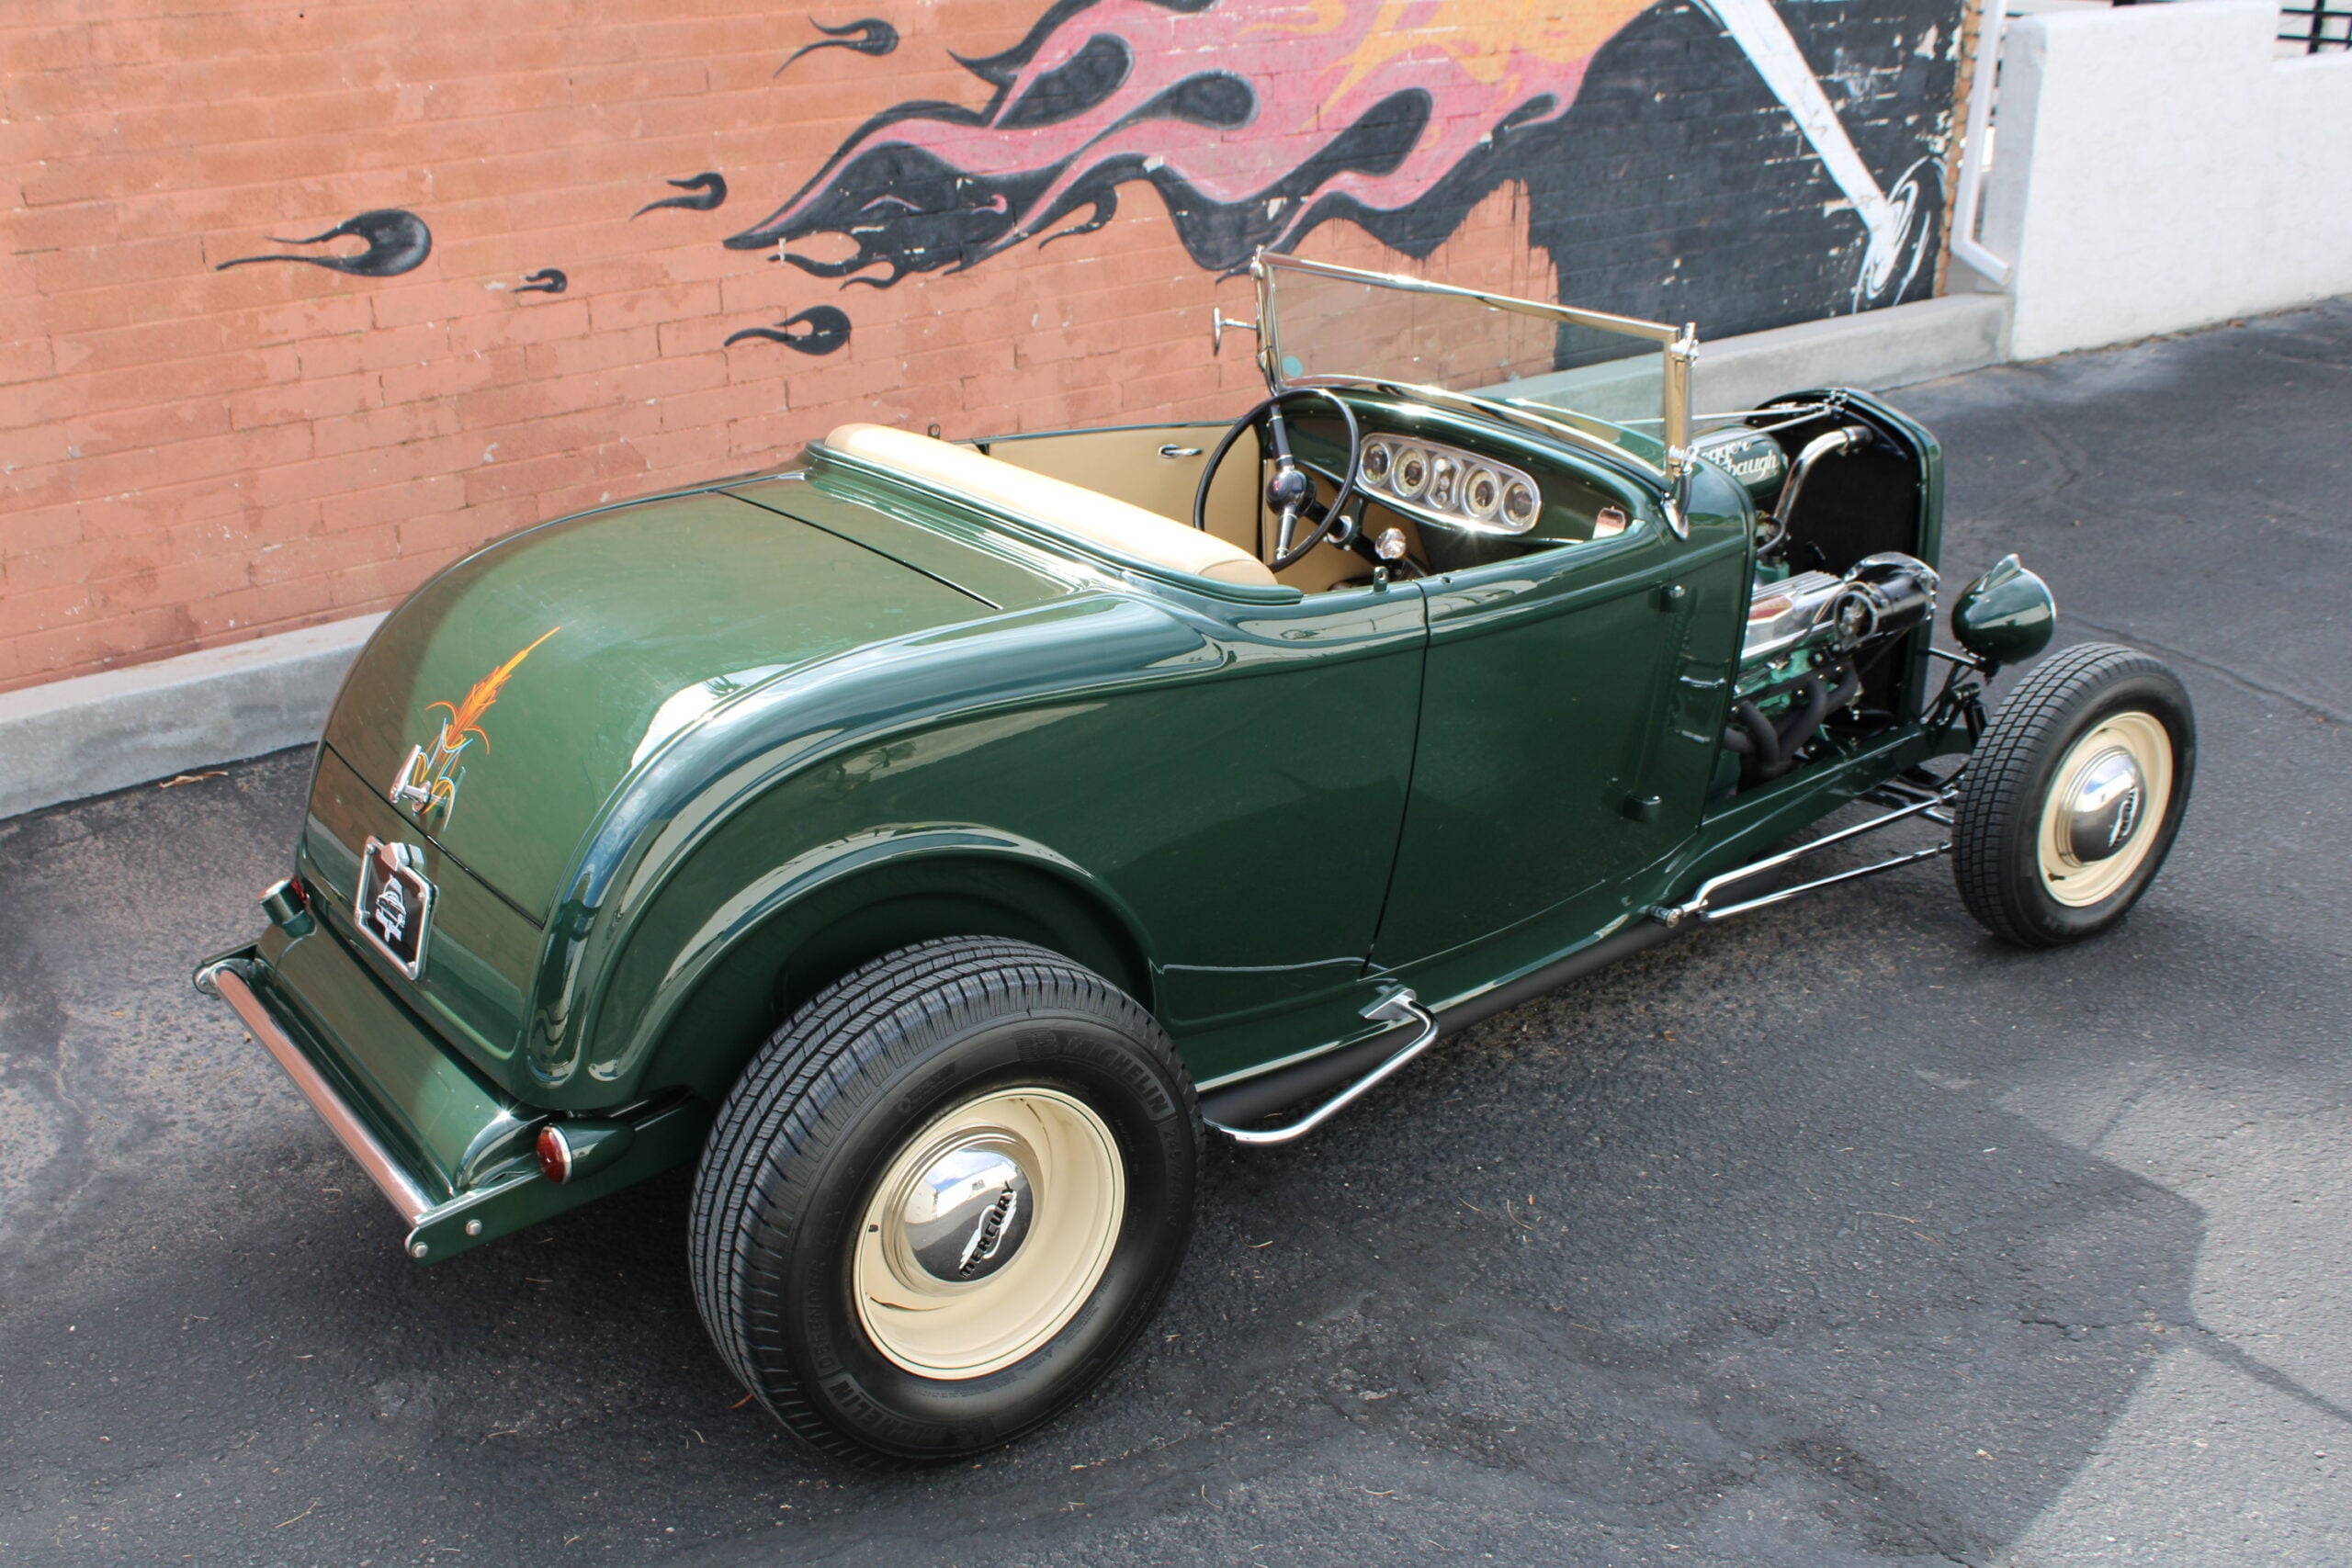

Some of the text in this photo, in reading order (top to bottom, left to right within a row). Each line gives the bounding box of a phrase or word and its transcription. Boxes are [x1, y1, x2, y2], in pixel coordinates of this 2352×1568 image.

[1060, 1035, 1170, 1117] MICHELIN
[958, 1180, 1014, 1279] MERCURY
[808, 1258, 834, 1371] DEFENDER
